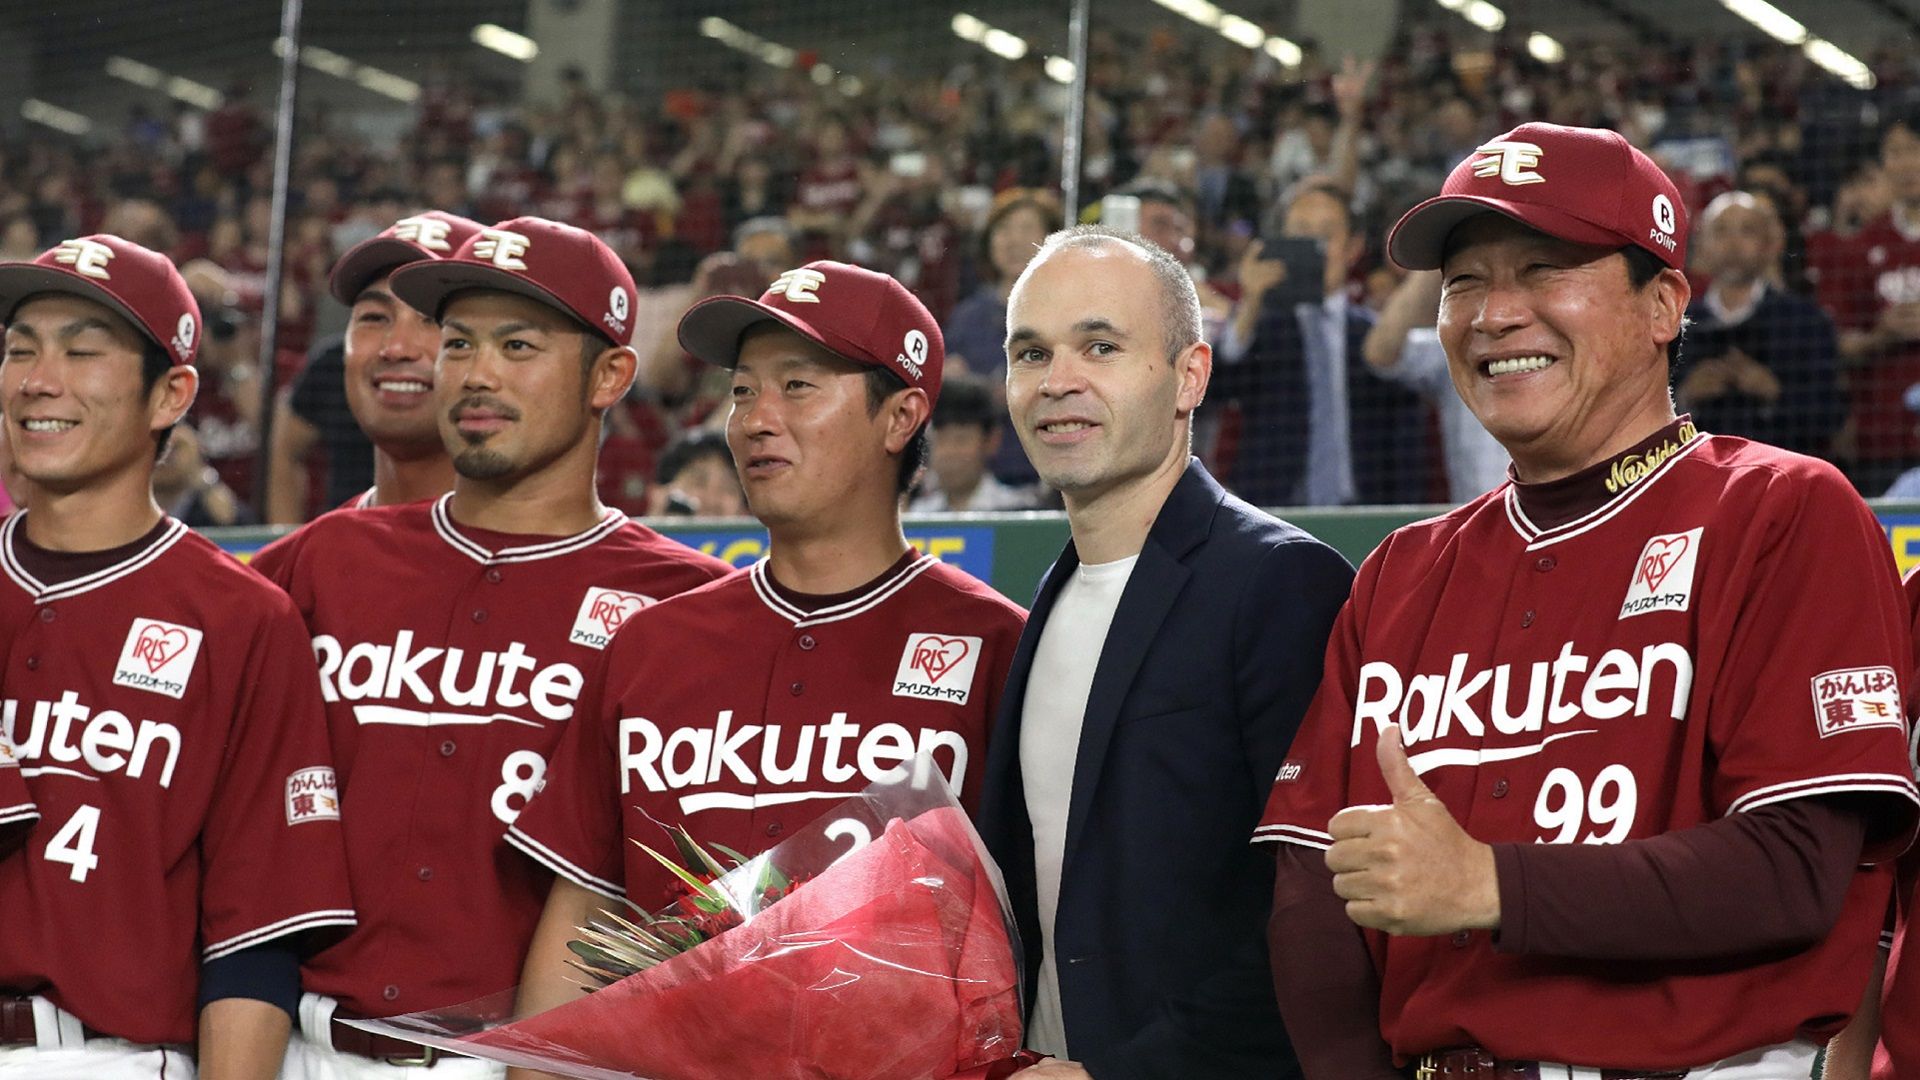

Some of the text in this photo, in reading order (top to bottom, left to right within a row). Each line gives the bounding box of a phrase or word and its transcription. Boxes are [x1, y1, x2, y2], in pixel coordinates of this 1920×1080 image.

[1660, 203, 1672, 228] R
[1650, 228, 1677, 253] POINT
[911, 338, 923, 360] R
[896, 353, 924, 381] POINT
[1636, 552, 1671, 585] IRIS
[588, 600, 627, 625] IRIS
[1621, 593, 1687, 615] アイリスオーヤマ
[132, 636, 170, 663] IRIS
[909, 648, 949, 671] IRIS
[117, 669, 183, 694] アイリスオーヤマ
[895, 681, 967, 702] アイリスオーヤマ
[1350, 641, 1693, 748] Rakuten
[1822, 699, 1857, 728] 東
[619, 710, 968, 798] Rakuten
[491, 750, 547, 824] 8
[1533, 764, 1638, 845] 99
[44, 804, 101, 883] 4
